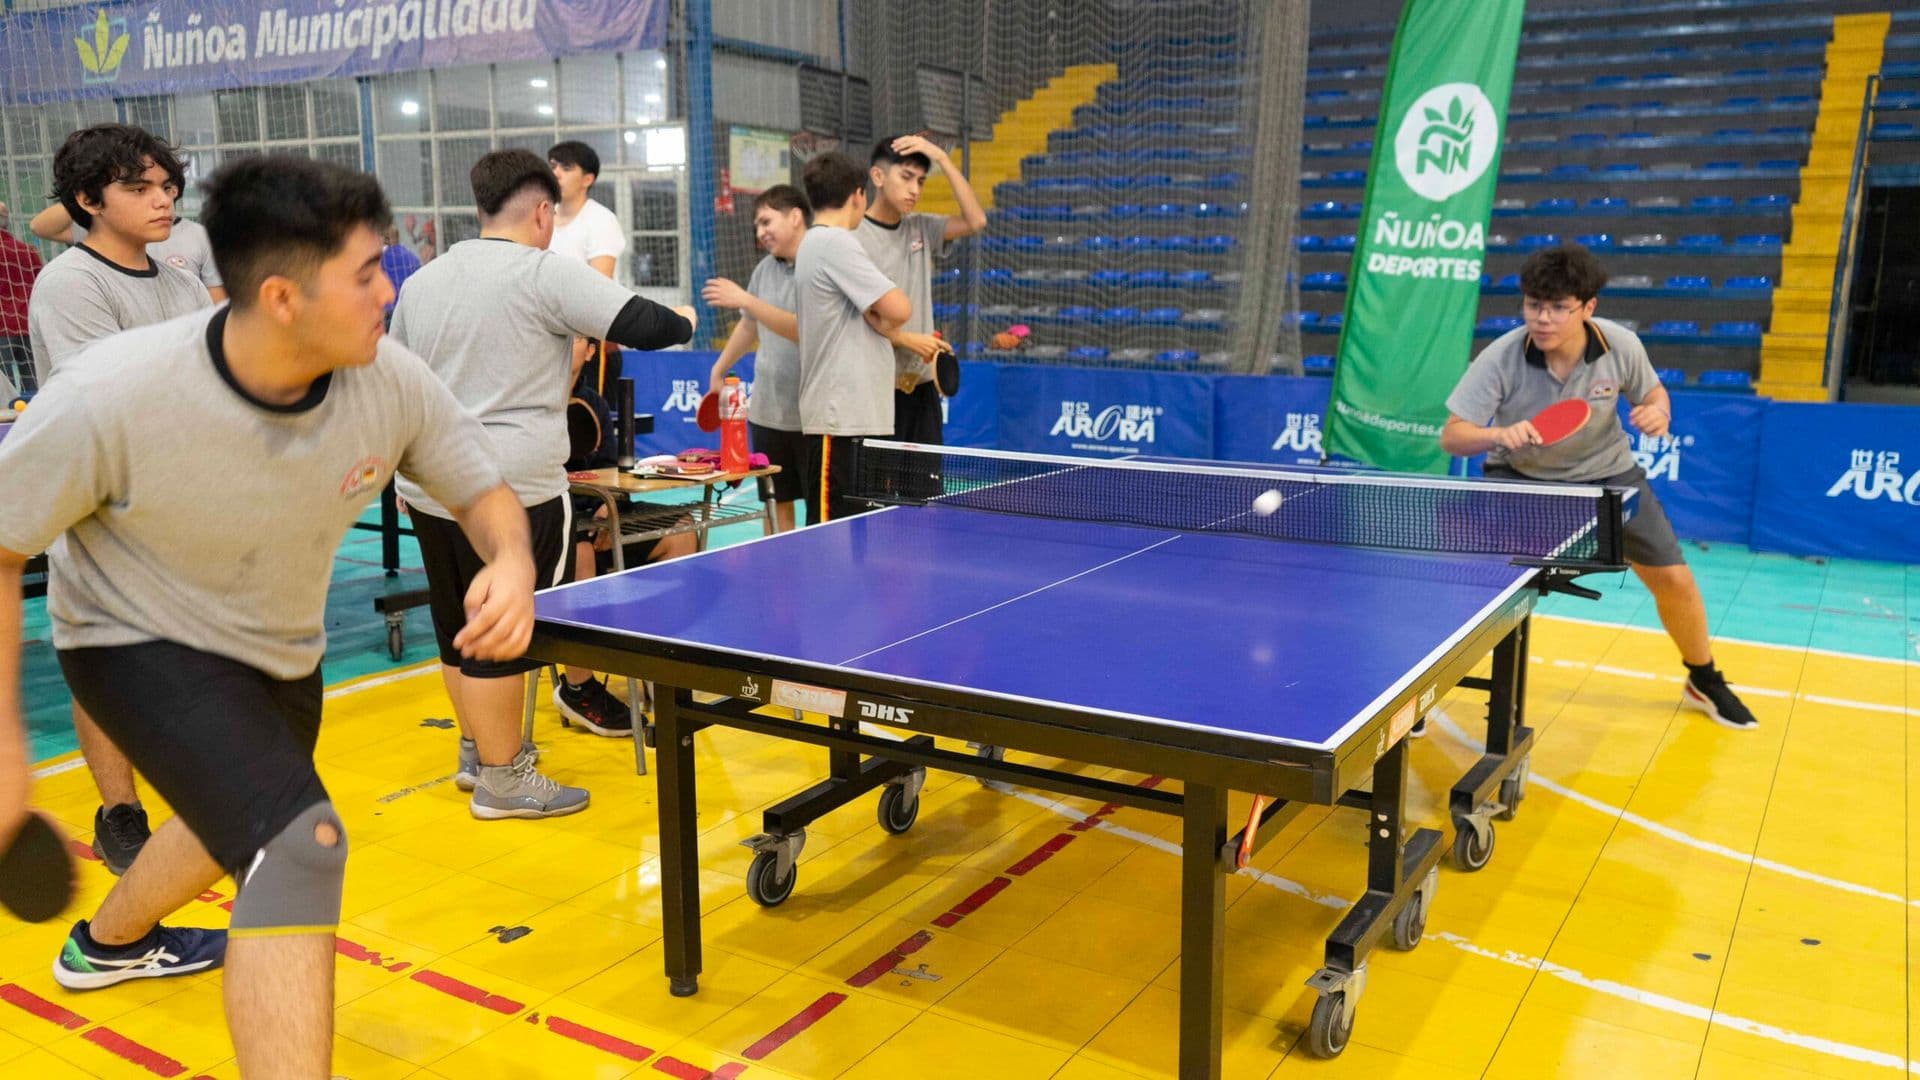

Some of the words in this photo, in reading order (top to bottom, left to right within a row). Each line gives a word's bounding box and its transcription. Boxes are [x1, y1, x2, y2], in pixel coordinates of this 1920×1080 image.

[143, 11, 247, 70] Ñuñoa
[255, 0, 537, 60] Municipalidad
[1374, 211, 1485, 250] ÑUÑOA
[1367, 252, 1482, 281] DEPORTES
[1049, 405, 1155, 443] AURORA
[1825, 468, 1920, 506] AUR
[857, 700, 915, 724] DHS
